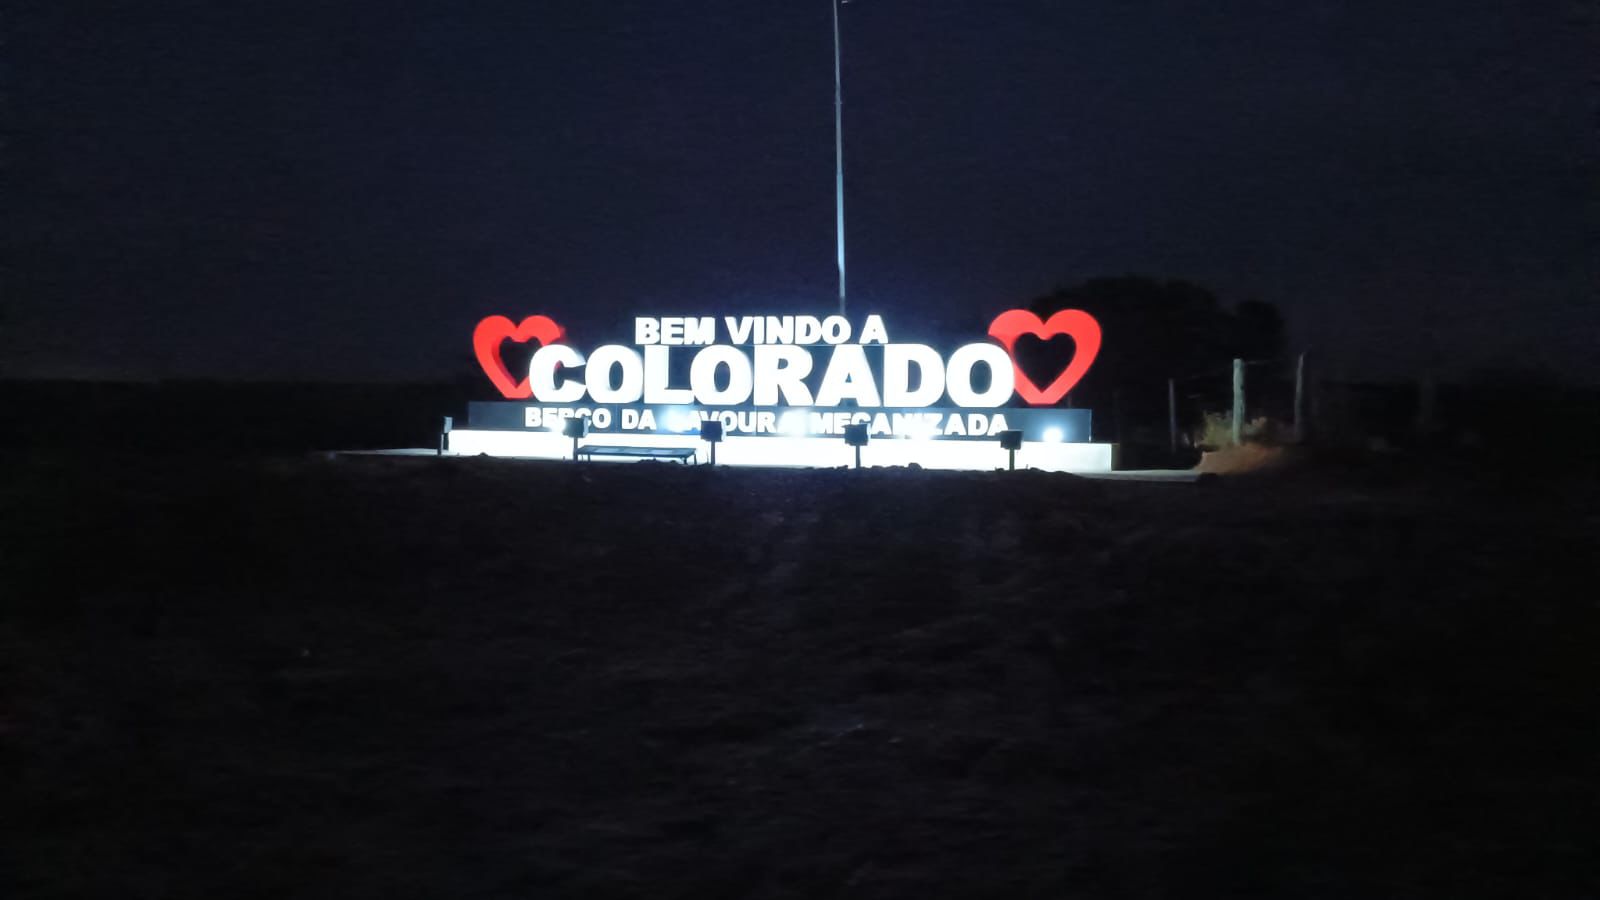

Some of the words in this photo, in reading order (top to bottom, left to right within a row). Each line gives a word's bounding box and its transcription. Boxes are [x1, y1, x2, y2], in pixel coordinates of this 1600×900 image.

[635, 317, 716, 345] BEM
[725, 316, 851, 344] VINDO
[859, 315, 888, 344] A
[528, 343, 1014, 408] COLORADO
[621, 409, 657, 430] DA
[667, 409, 804, 433] AVOUR
[811, 412, 1009, 437] MECANZADA
